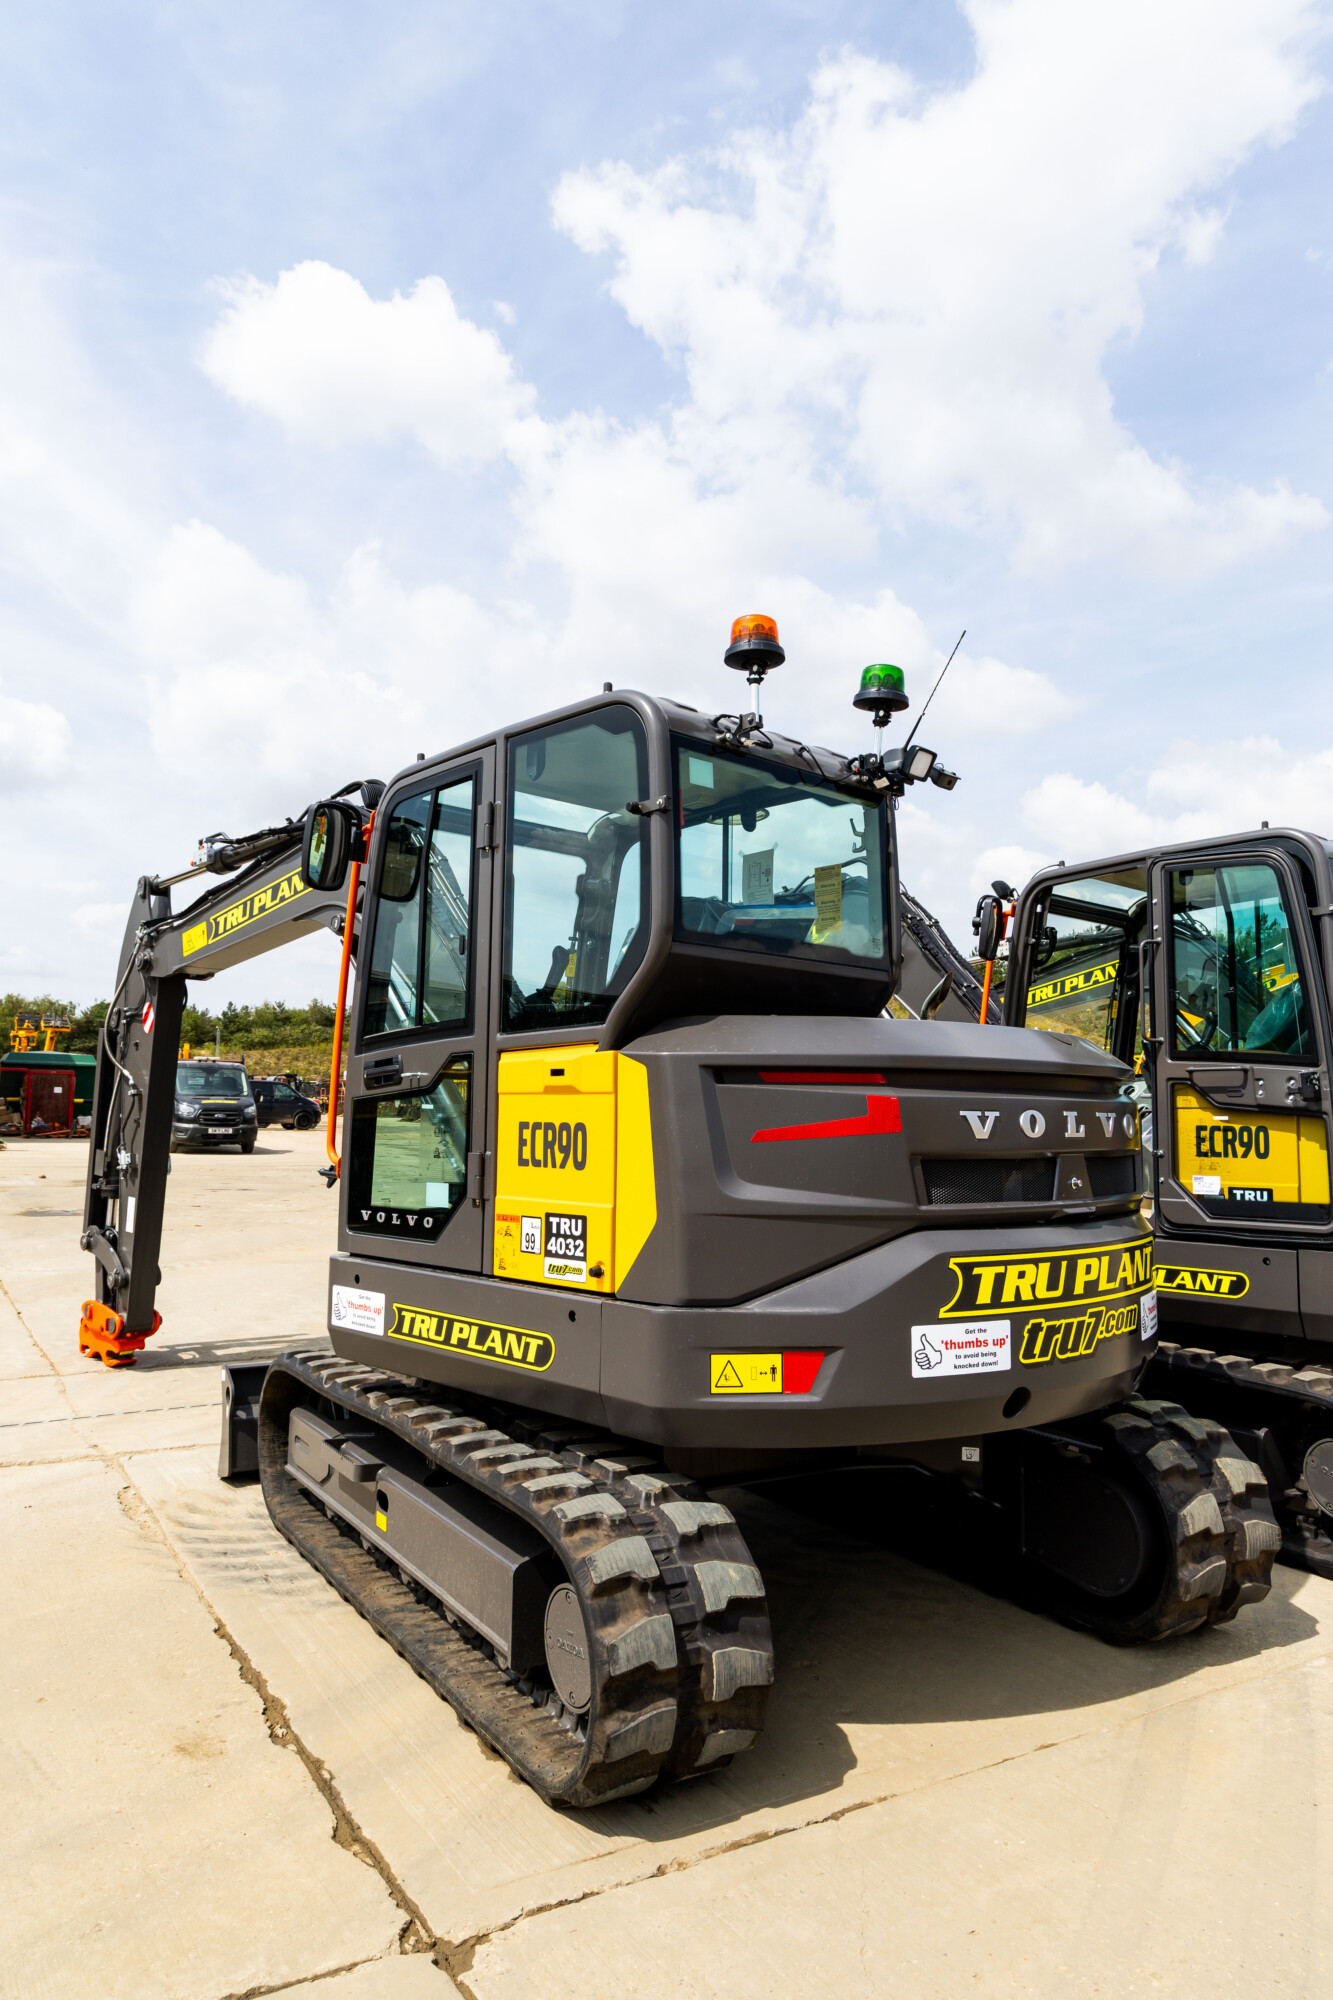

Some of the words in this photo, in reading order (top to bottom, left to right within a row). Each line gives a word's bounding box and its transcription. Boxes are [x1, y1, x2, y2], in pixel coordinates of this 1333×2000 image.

[217, 900, 250, 934] TRU
[253, 874, 304, 916] PLAN
[1027, 982, 1061, 1004] TRU
[1065, 964, 1119, 993] PLAN
[960, 1110, 1135, 1140] VOLVO
[518, 1121, 587, 1171] ECR90
[1196, 1125, 1270, 1159] ECR90
[1233, 1190, 1268, 1202] TRU
[361, 1210, 433, 1228] VOLVO
[549, 1216, 582, 1236] TRU
[525, 1233, 535, 1250] 99
[547, 1236, 584, 1257] 4032
[548, 1264, 583, 1276] tru7.com
[972, 1261, 1067, 1305] TRU
[1074, 1246, 1152, 1295] PLANT
[1156, 1270, 1236, 1293] LANT
[401, 1311, 448, 1342] TRU
[450, 1322, 543, 1363] PLANT
[992, 1335, 1008, 1348] up'
[1019, 1304, 1138, 1364] tru7.com
